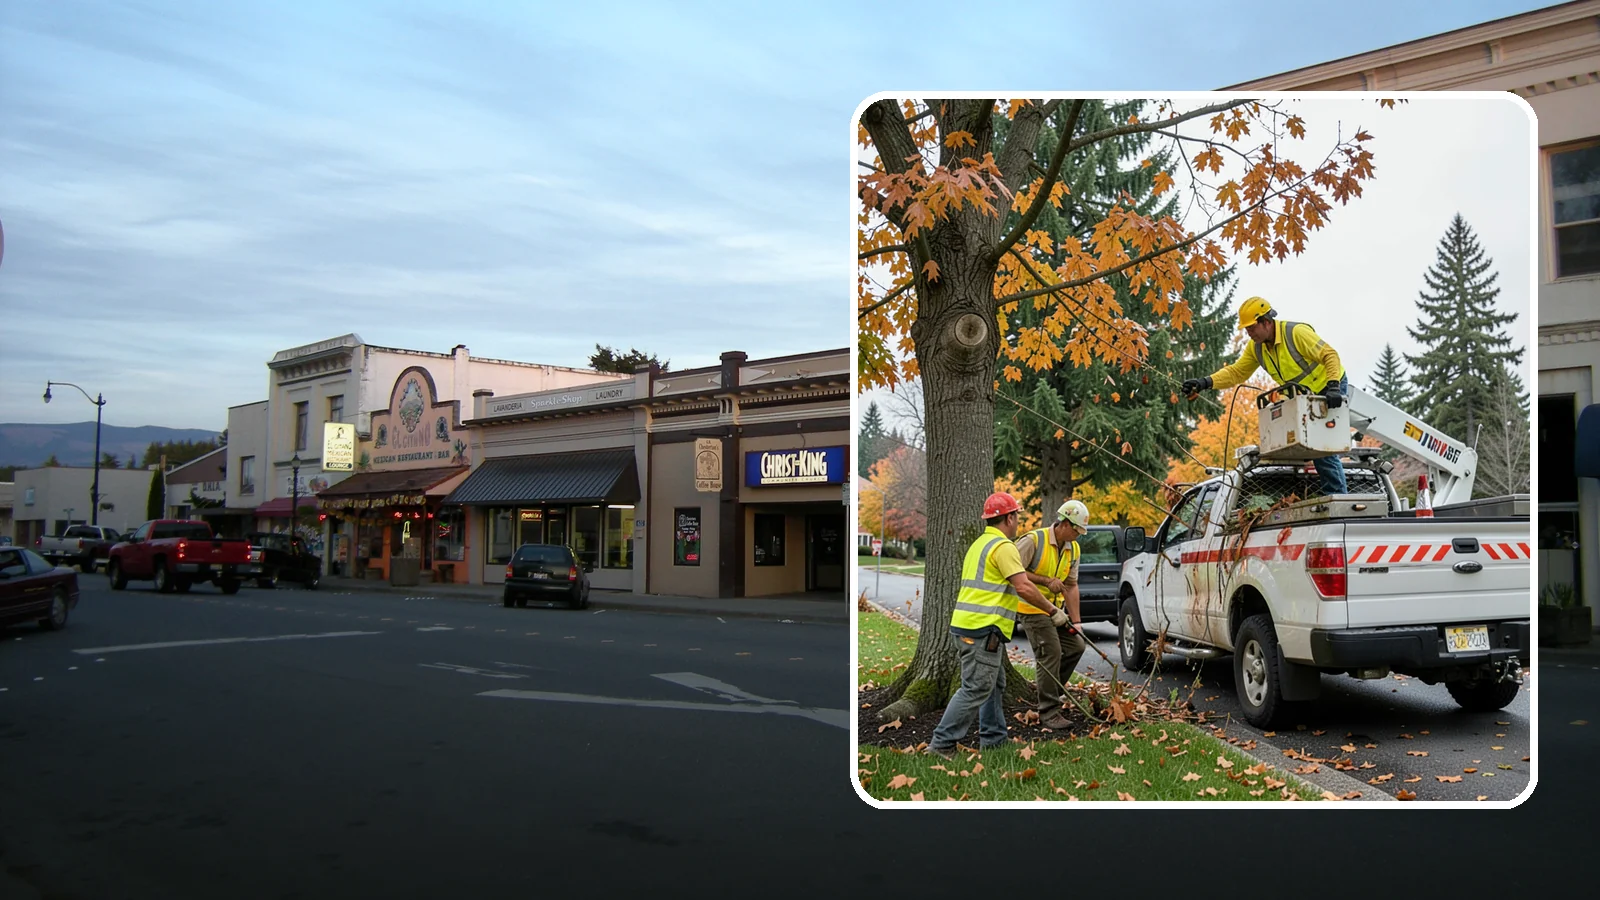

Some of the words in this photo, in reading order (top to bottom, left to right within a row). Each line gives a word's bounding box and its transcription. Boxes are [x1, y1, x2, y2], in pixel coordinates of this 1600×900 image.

[562, 394, 582, 404] Shop
[595, 389, 623, 399] LAUNDRY
[493, 402, 522, 412] LAVANDERIA
[373, 454, 396, 464] MEXICAN
[397, 451, 433, 462] RESTAURANT
[437, 450, 450, 459] BAR
[761, 452, 797, 477] CHRIST
[799, 450, 827, 476] KING
